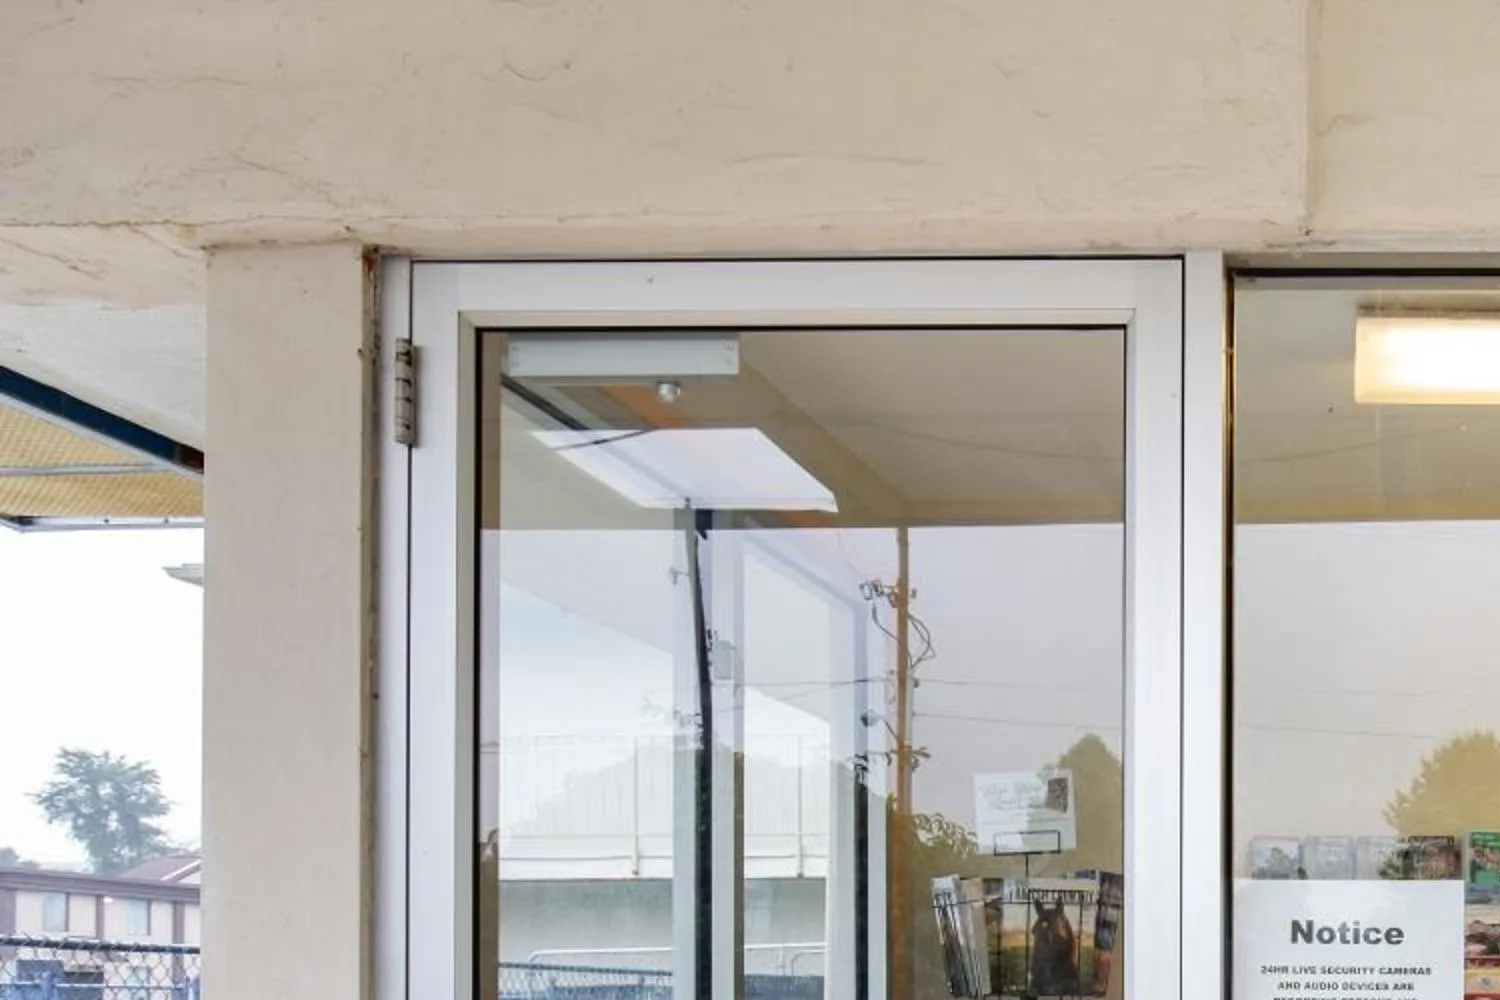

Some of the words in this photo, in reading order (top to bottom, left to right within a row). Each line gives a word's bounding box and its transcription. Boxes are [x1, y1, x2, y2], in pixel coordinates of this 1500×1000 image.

[1290, 919, 1405, 945] Notice
[1260, 965, 1289, 975] 24HR
[1292, 966, 1317, 975] LIVE
[1320, 966, 1375, 975] SECURITY
[1379, 966, 1432, 976] CAMERAS
[1277, 982, 1300, 991] AND
[1303, 982, 1339, 991] AUDIO
[1342, 982, 1389, 991] DEVICES
[1392, 982, 1415, 991] ARE
